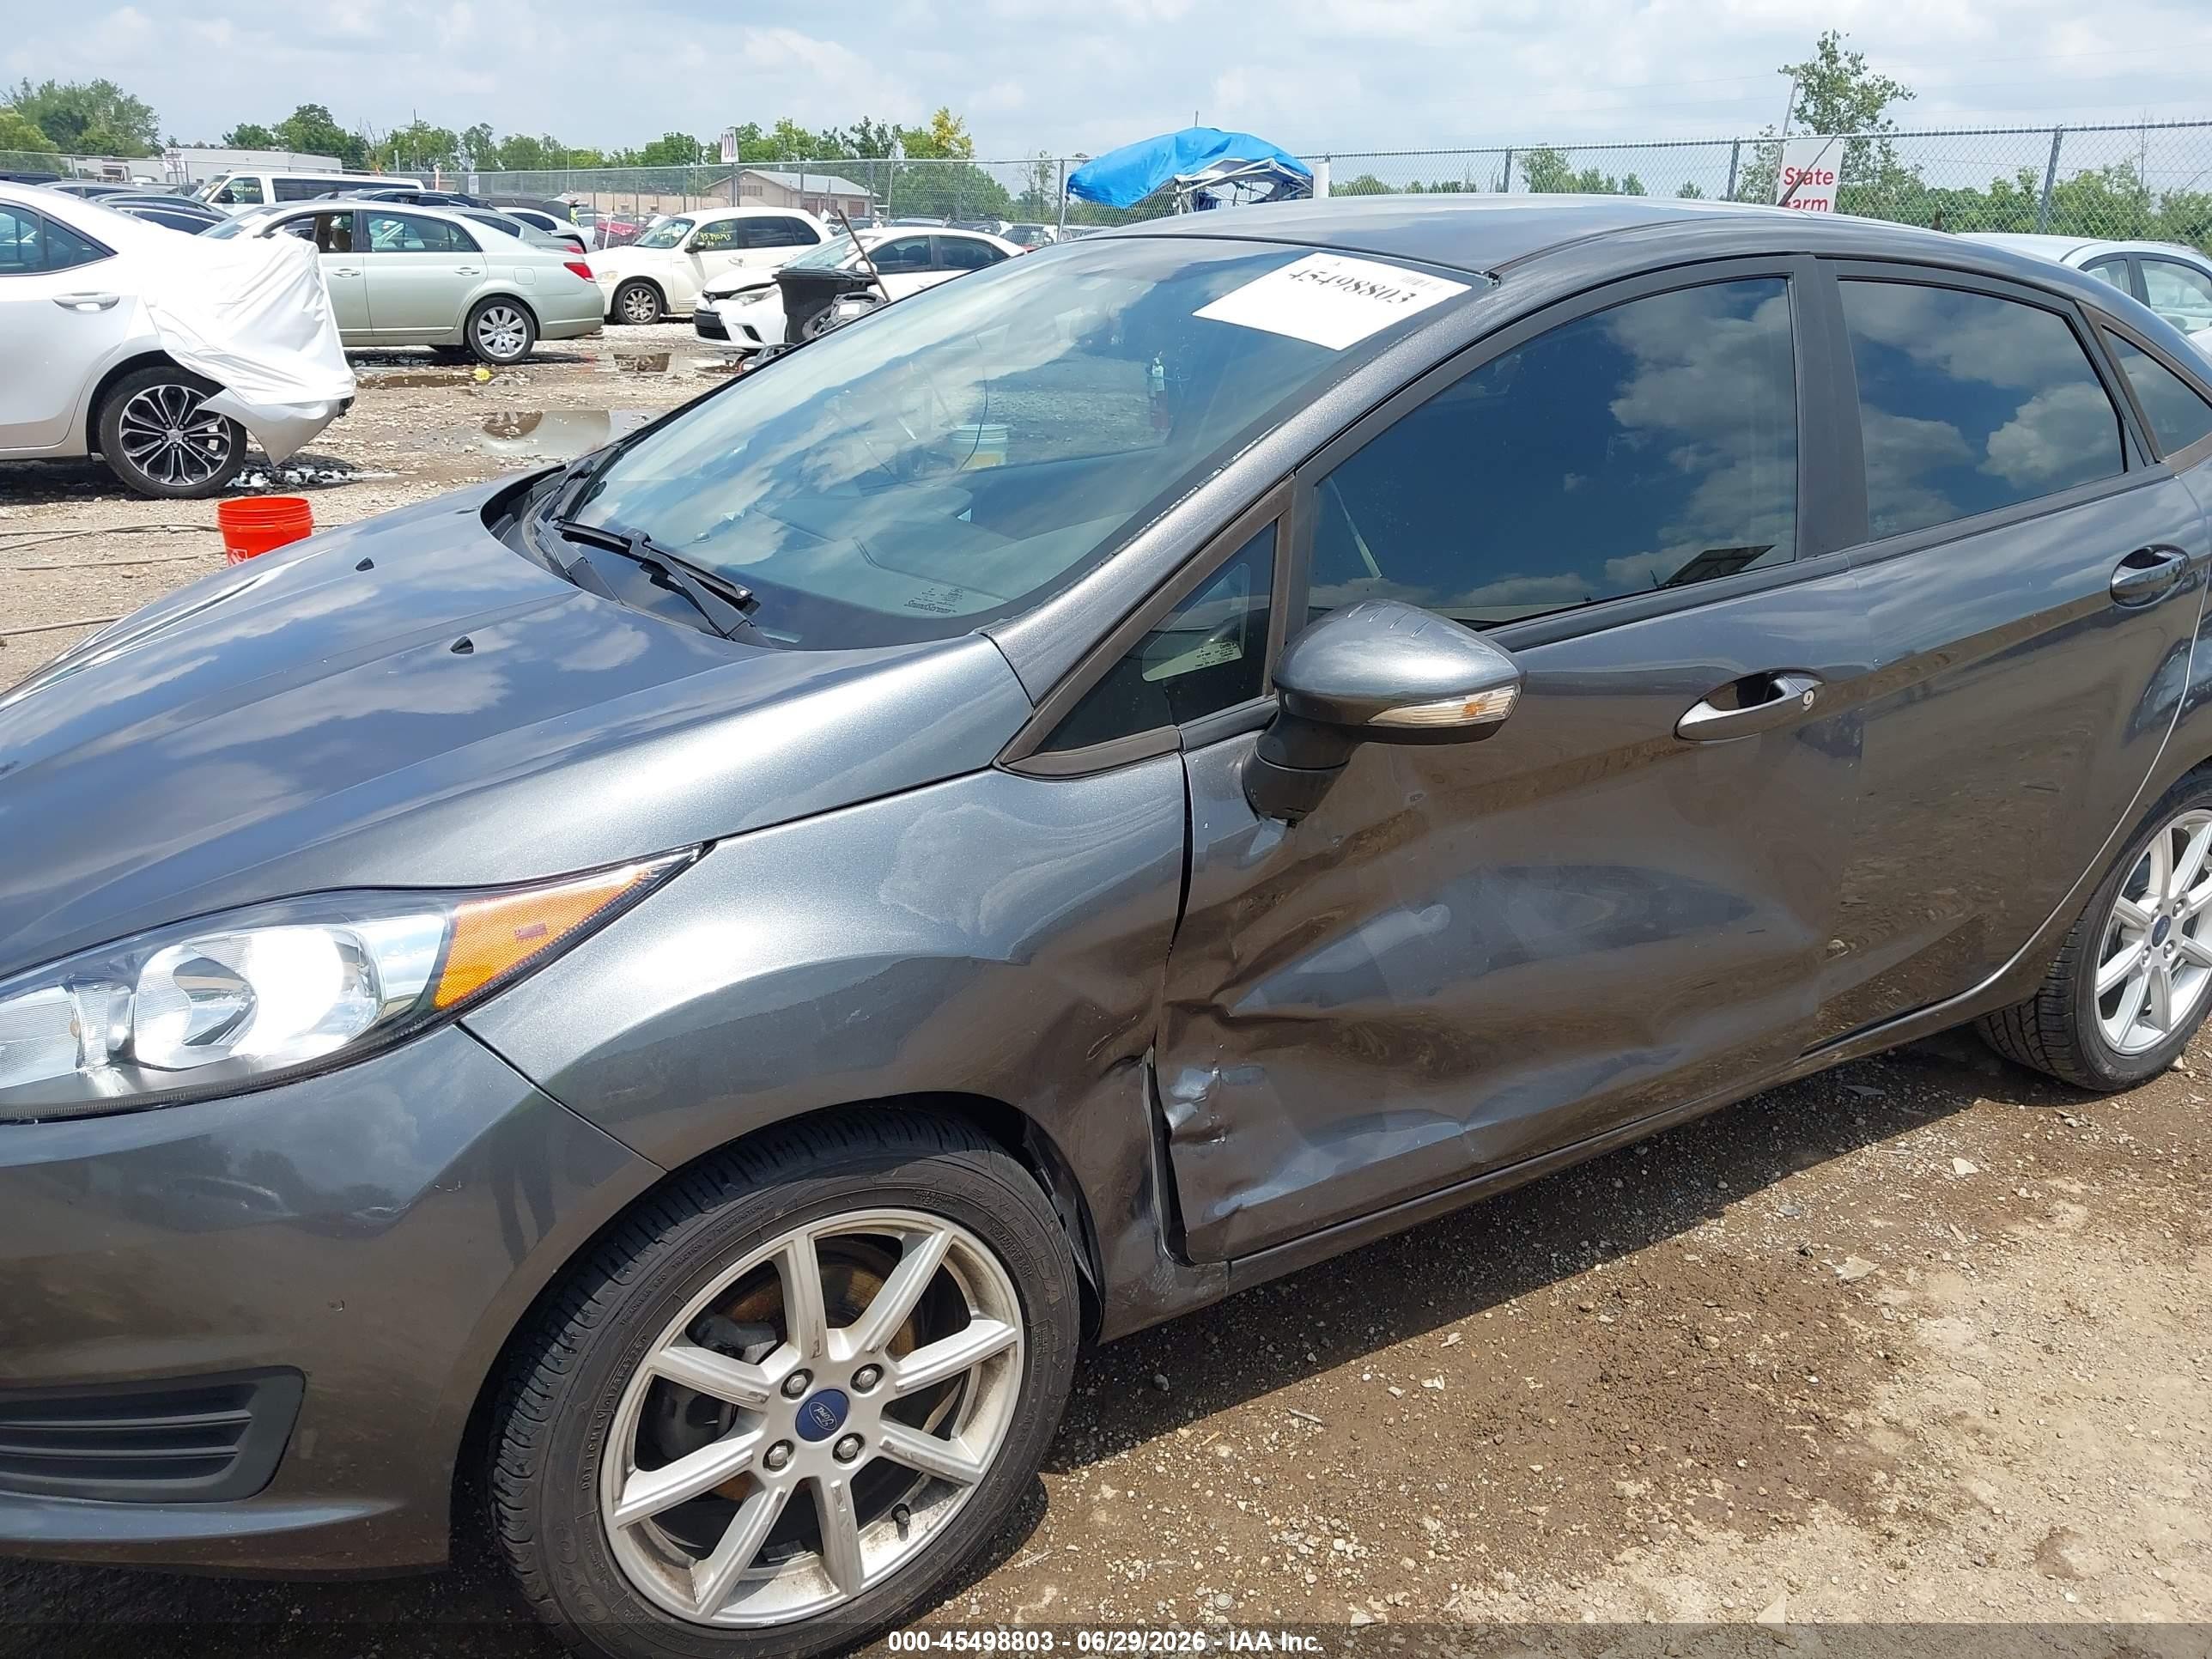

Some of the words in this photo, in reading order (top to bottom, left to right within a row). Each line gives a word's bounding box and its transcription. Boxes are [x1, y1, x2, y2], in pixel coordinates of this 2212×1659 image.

[1784, 167, 1834, 185] State
[1785, 198, 1828, 211] arm
[812, 1405, 836, 1428] Ford
